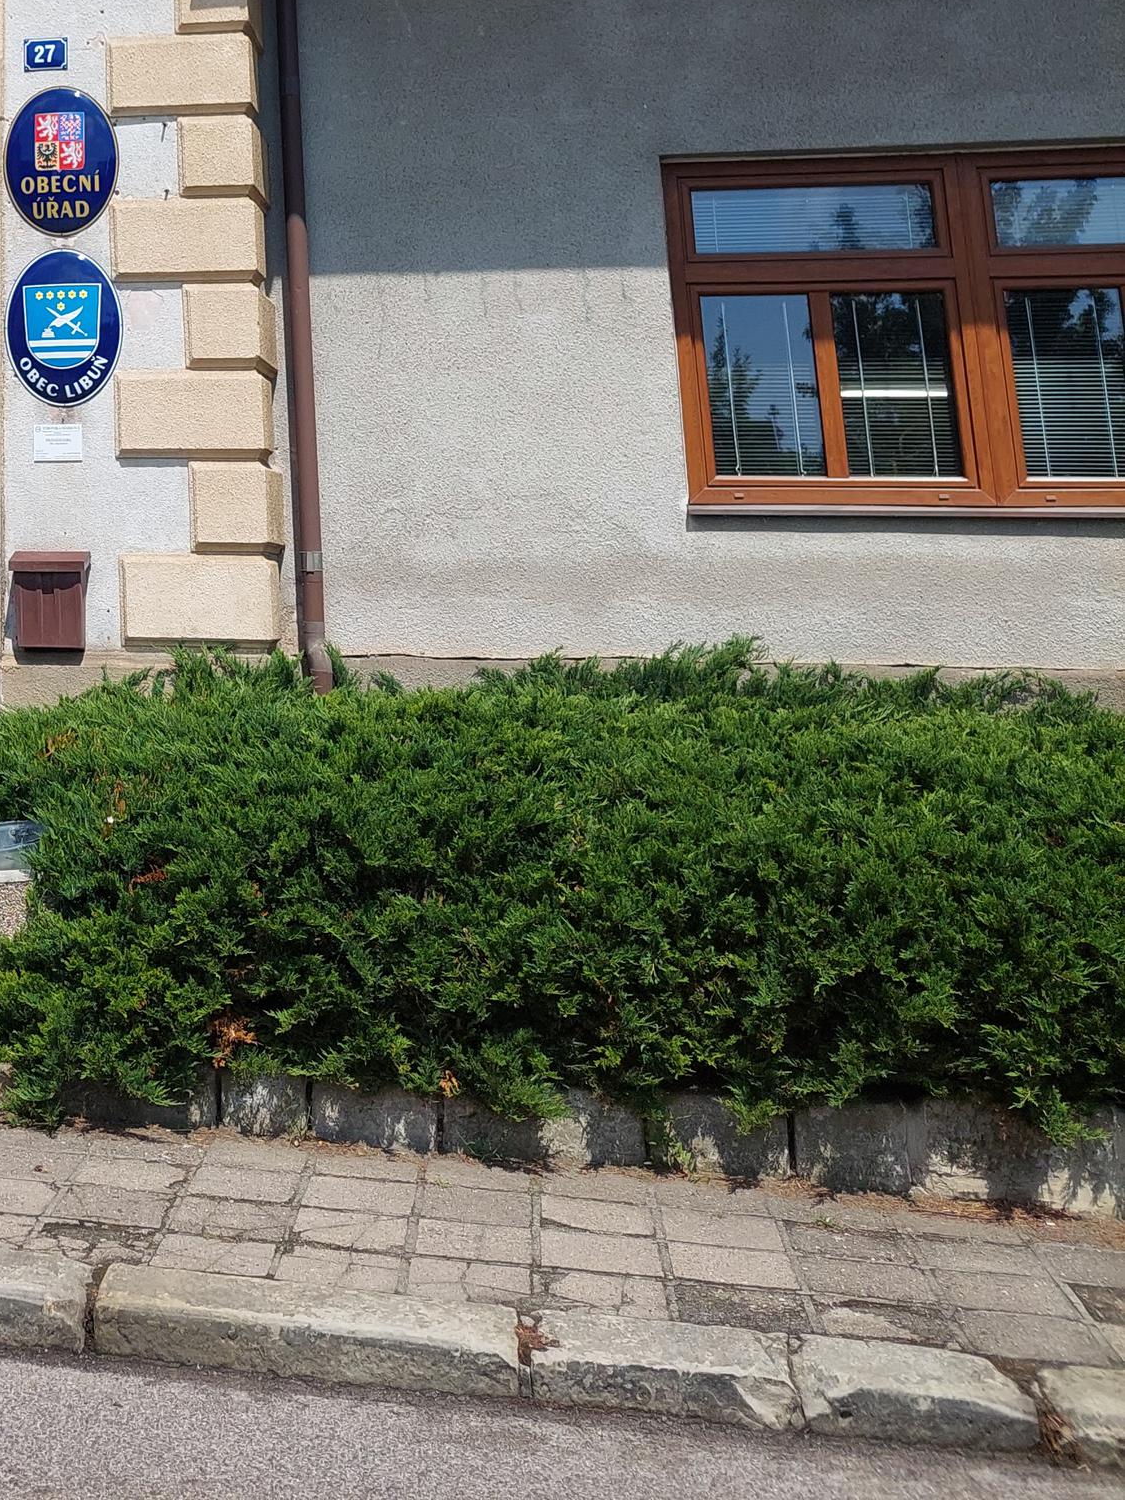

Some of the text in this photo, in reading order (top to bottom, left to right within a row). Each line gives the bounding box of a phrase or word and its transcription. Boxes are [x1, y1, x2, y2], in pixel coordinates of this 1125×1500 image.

[34, 44, 56, 63] 27
[20, 170, 100, 194] OBECNÍ
[32, 197, 90, 219] ÚŘAD
[19, 355, 109, 398] OBEC LIBUŇ
